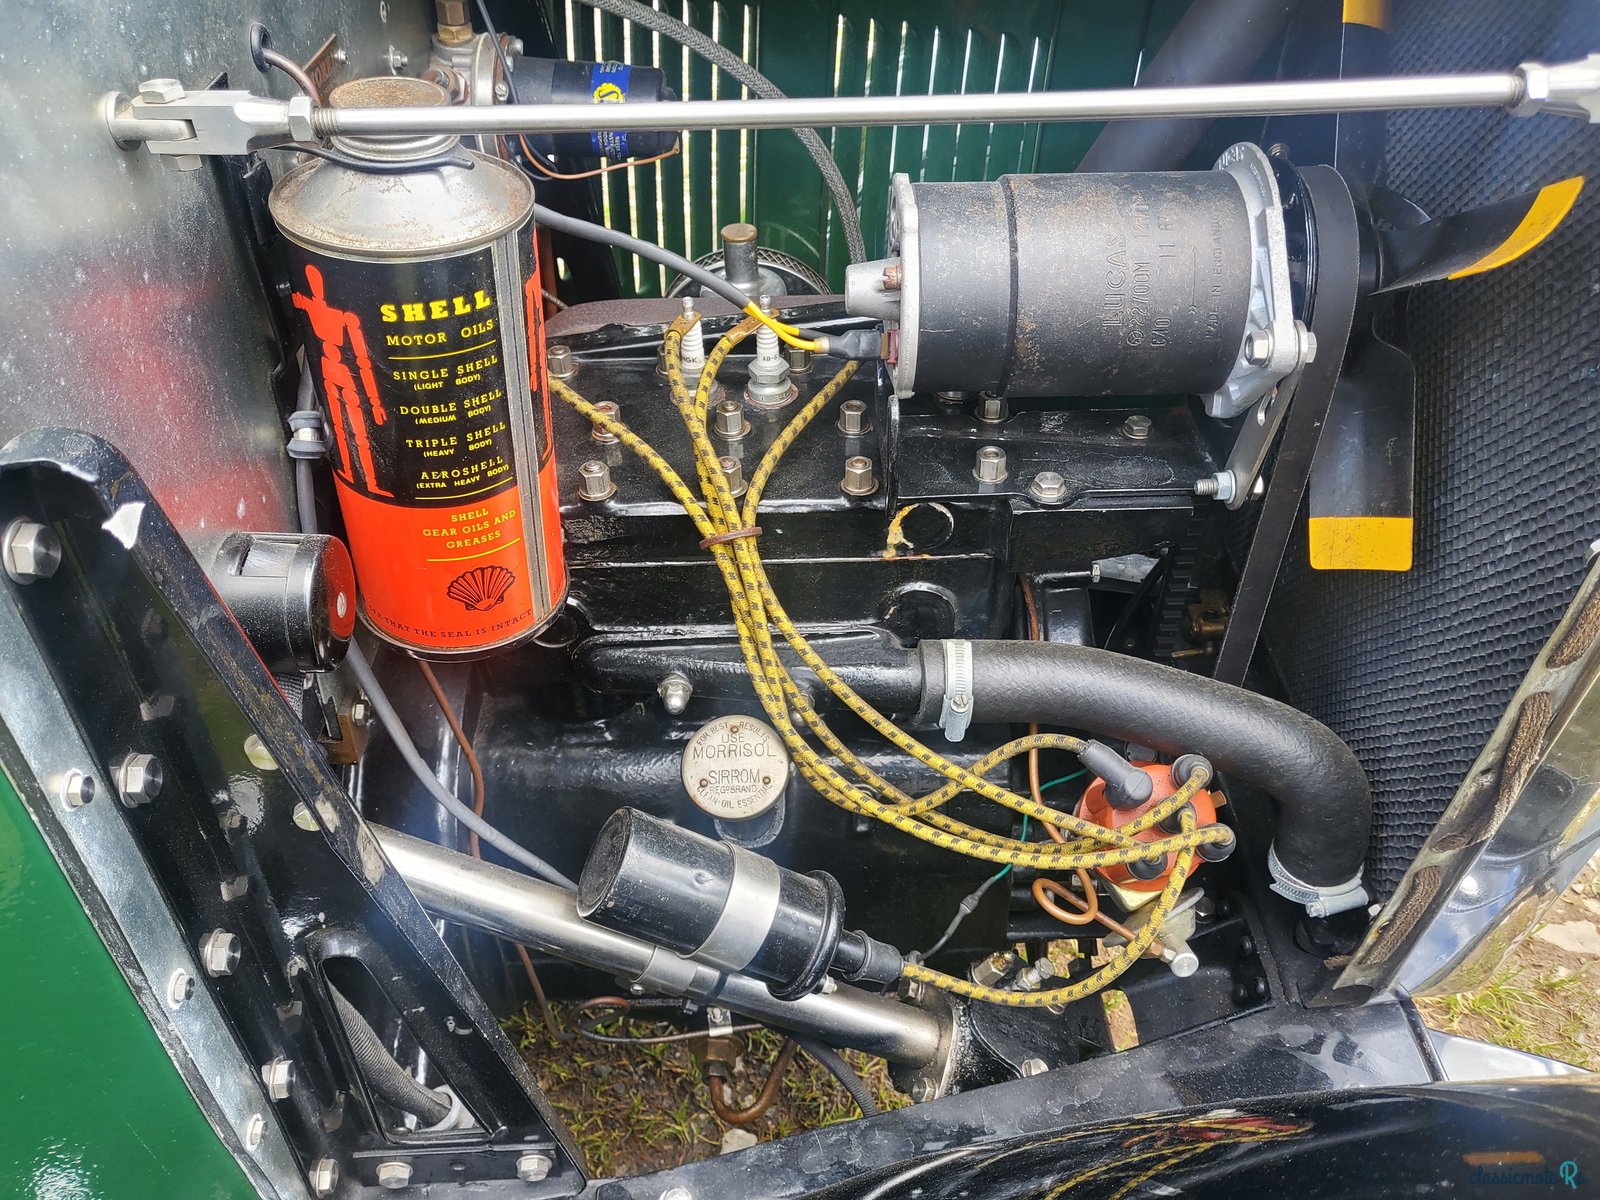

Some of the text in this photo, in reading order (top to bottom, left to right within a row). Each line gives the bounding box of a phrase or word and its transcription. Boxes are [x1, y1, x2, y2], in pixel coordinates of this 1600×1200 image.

[1101, 232, 1127, 327] LUCAS
[379, 289, 491, 323] SHELL
[385, 318, 495, 346] MOTOR OILS
[392, 354, 498, 380] SINGLE SHELL
[413, 373, 481, 391] (LIGHT BODY)
[399, 388, 502, 415] DOUBLE SHELL
[415, 405, 492, 425] (MEDIUM BODY)
[405, 421, 506, 448] TRIPLE SHELL
[423, 438, 492, 458] (HEAVY BODY)
[420, 455, 503, 480] AEROSHELL
[453, 474, 481, 487] HEAVY
[487, 463, 509, 477] BODY)
[422, 509, 516, 537] GEAR OILS AND
[451, 508, 489, 522] SHELL
[446, 530, 501, 549] GREASES
[384, 616, 410, 632] THAT
[413, 627, 436, 637] THE
[476, 627, 487, 635] IS
[491, 608, 532, 632] INTACT
[696, 732, 710, 746] FOR
[739, 721, 770, 743] RESULTS
[721, 732, 745, 744] USE
[692, 742, 777, 760] MORRISOL
[708, 769, 761, 785] SIRROM
[737, 783, 774, 808] ESSENTIAL
